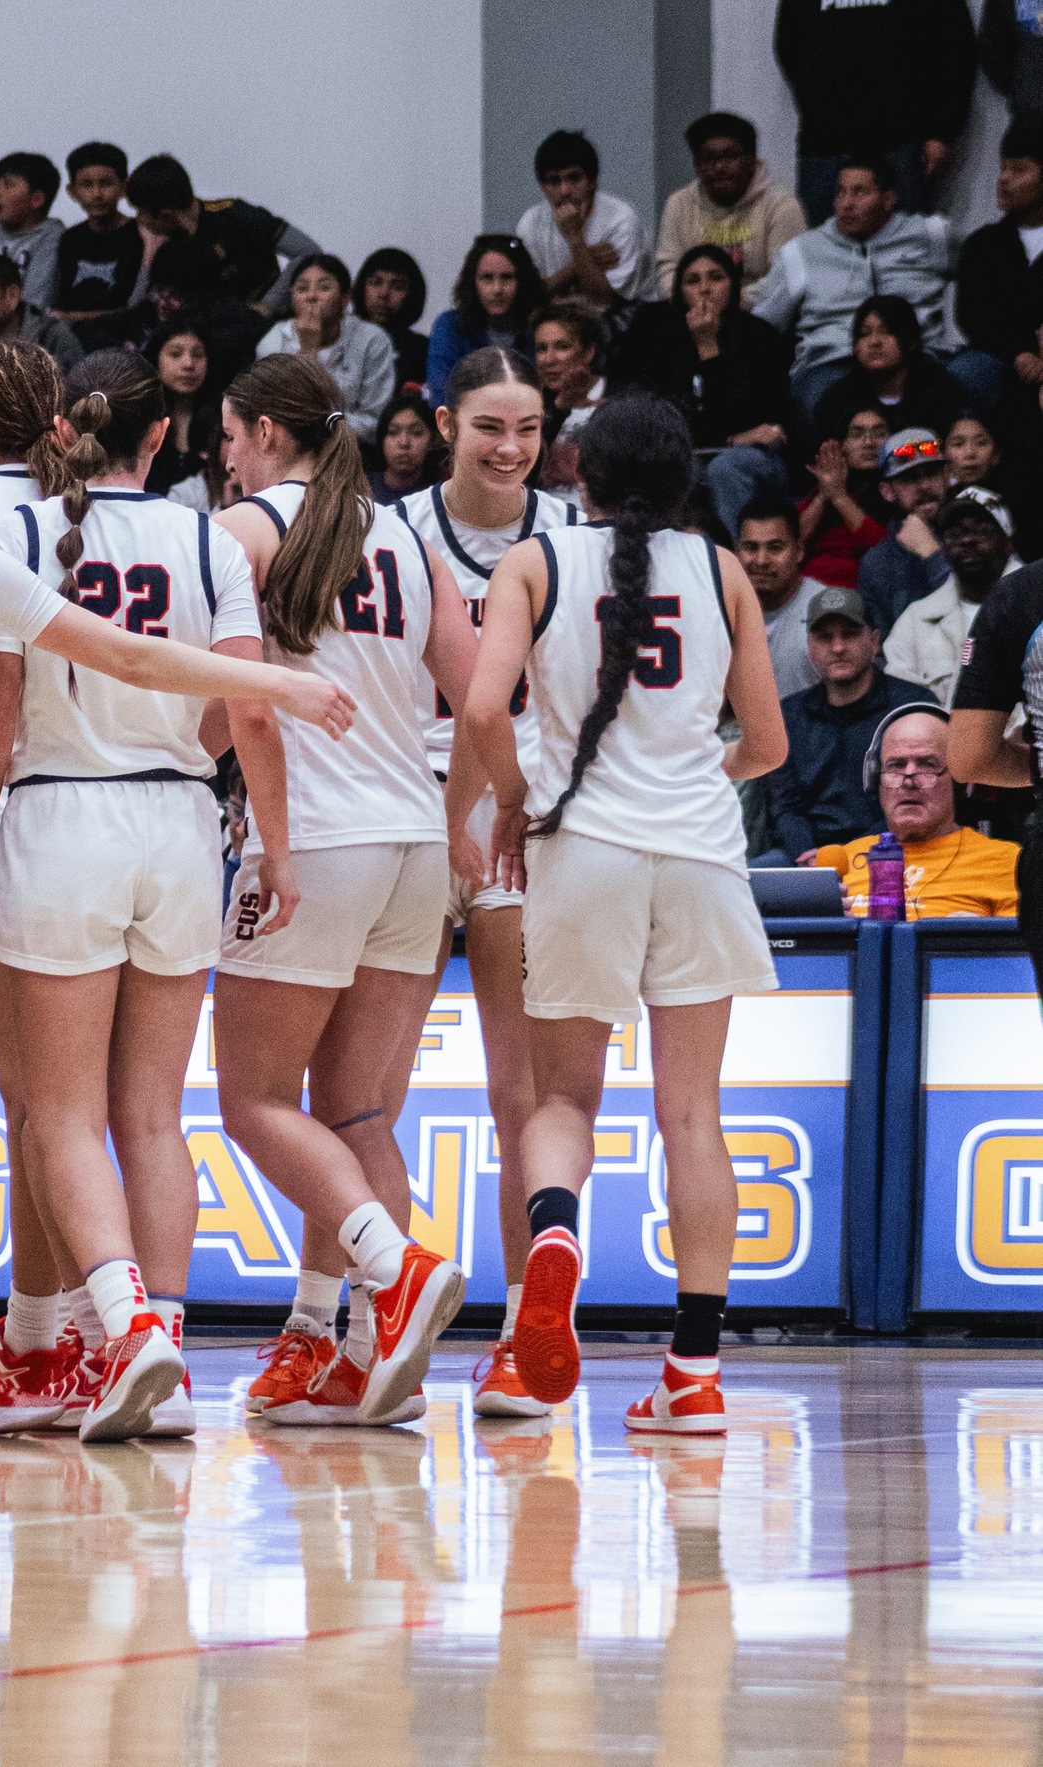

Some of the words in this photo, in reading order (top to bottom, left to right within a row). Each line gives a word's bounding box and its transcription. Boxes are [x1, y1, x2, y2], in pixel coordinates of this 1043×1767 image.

[74, 560, 171, 639] 22
[337, 547, 406, 640] 21
[235, 892, 260, 941] COS
